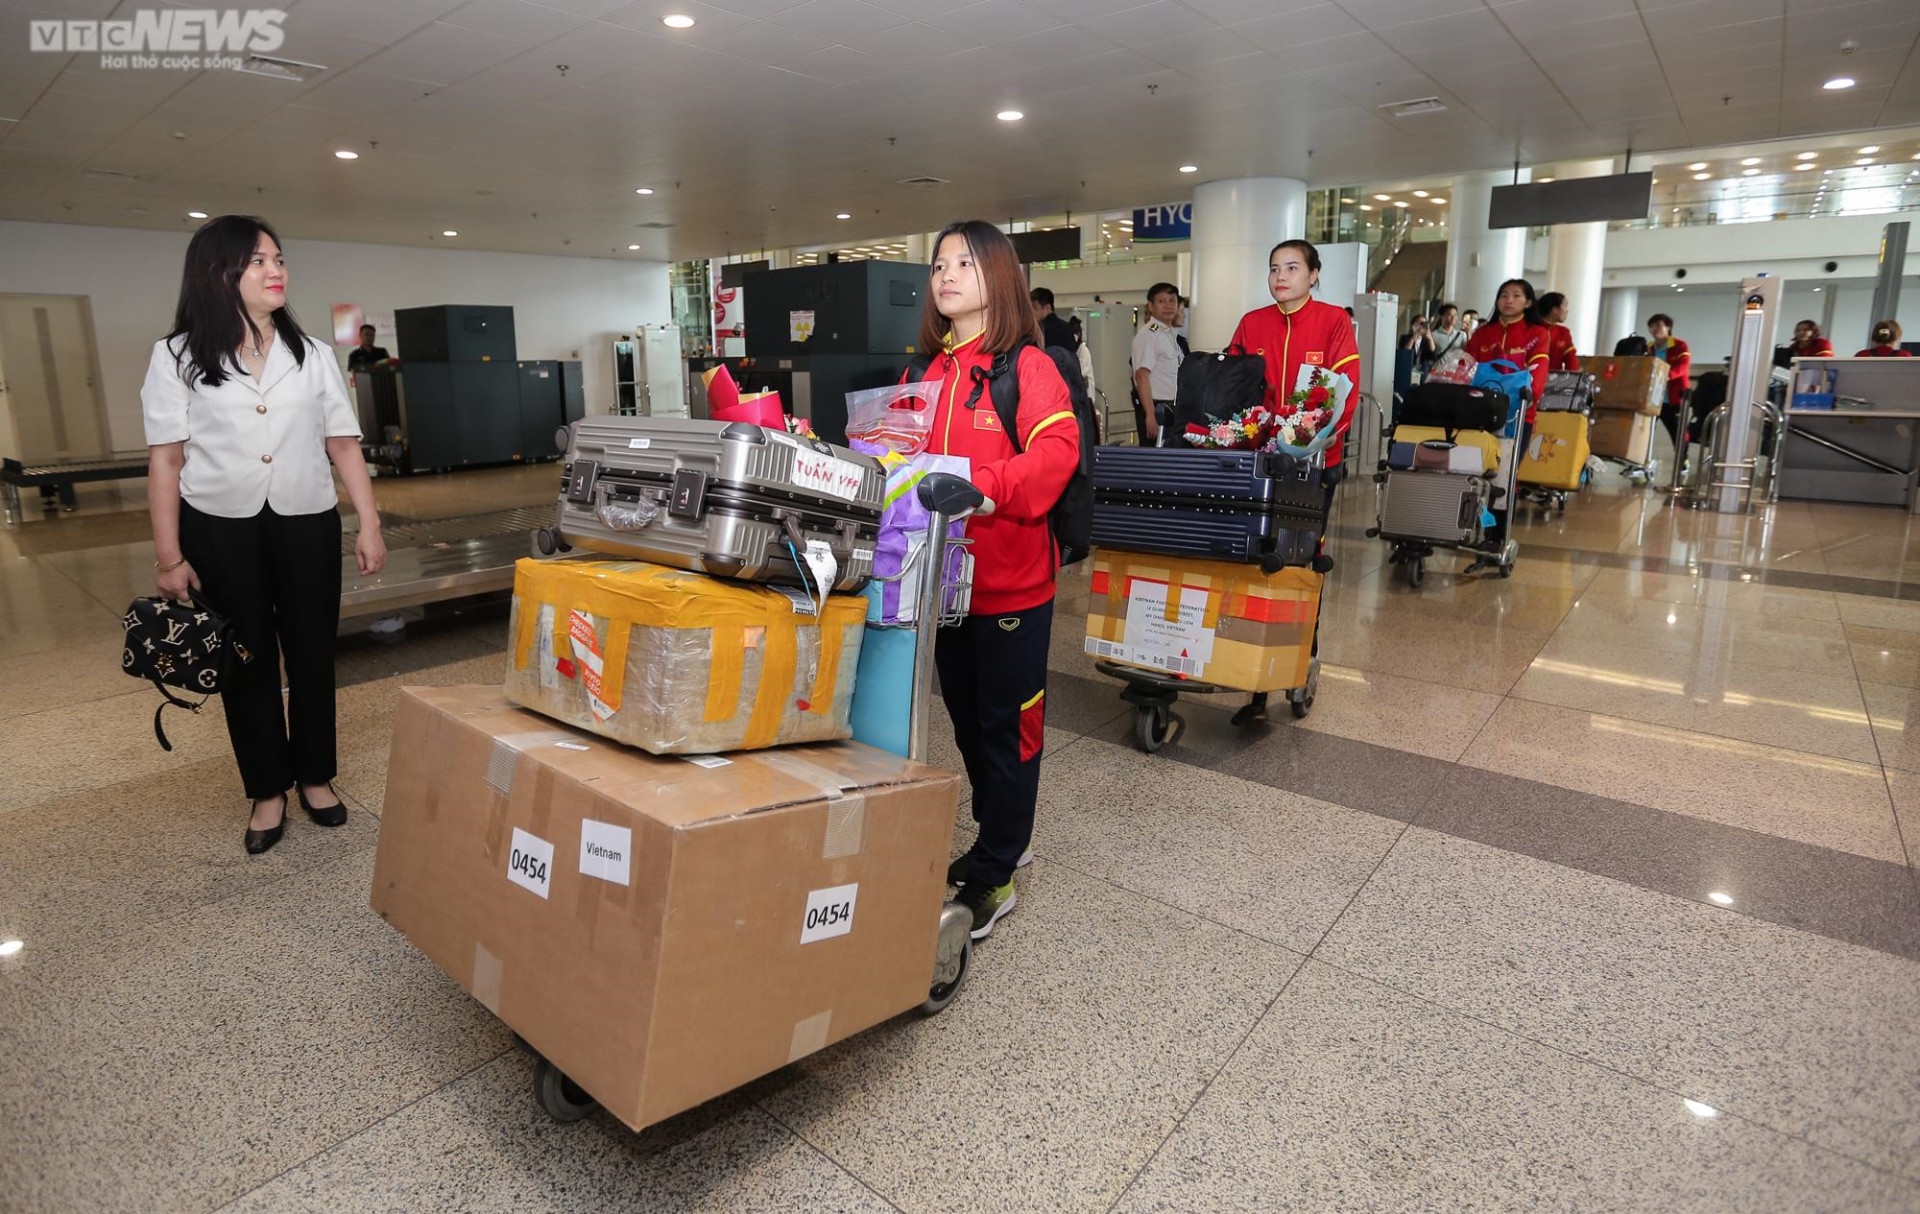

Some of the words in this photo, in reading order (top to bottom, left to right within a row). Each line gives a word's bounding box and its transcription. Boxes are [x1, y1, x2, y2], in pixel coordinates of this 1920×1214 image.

[586, 841, 622, 863] Vietnam
[511, 848, 548, 885] 0454
[806, 902, 850, 930] 0454
